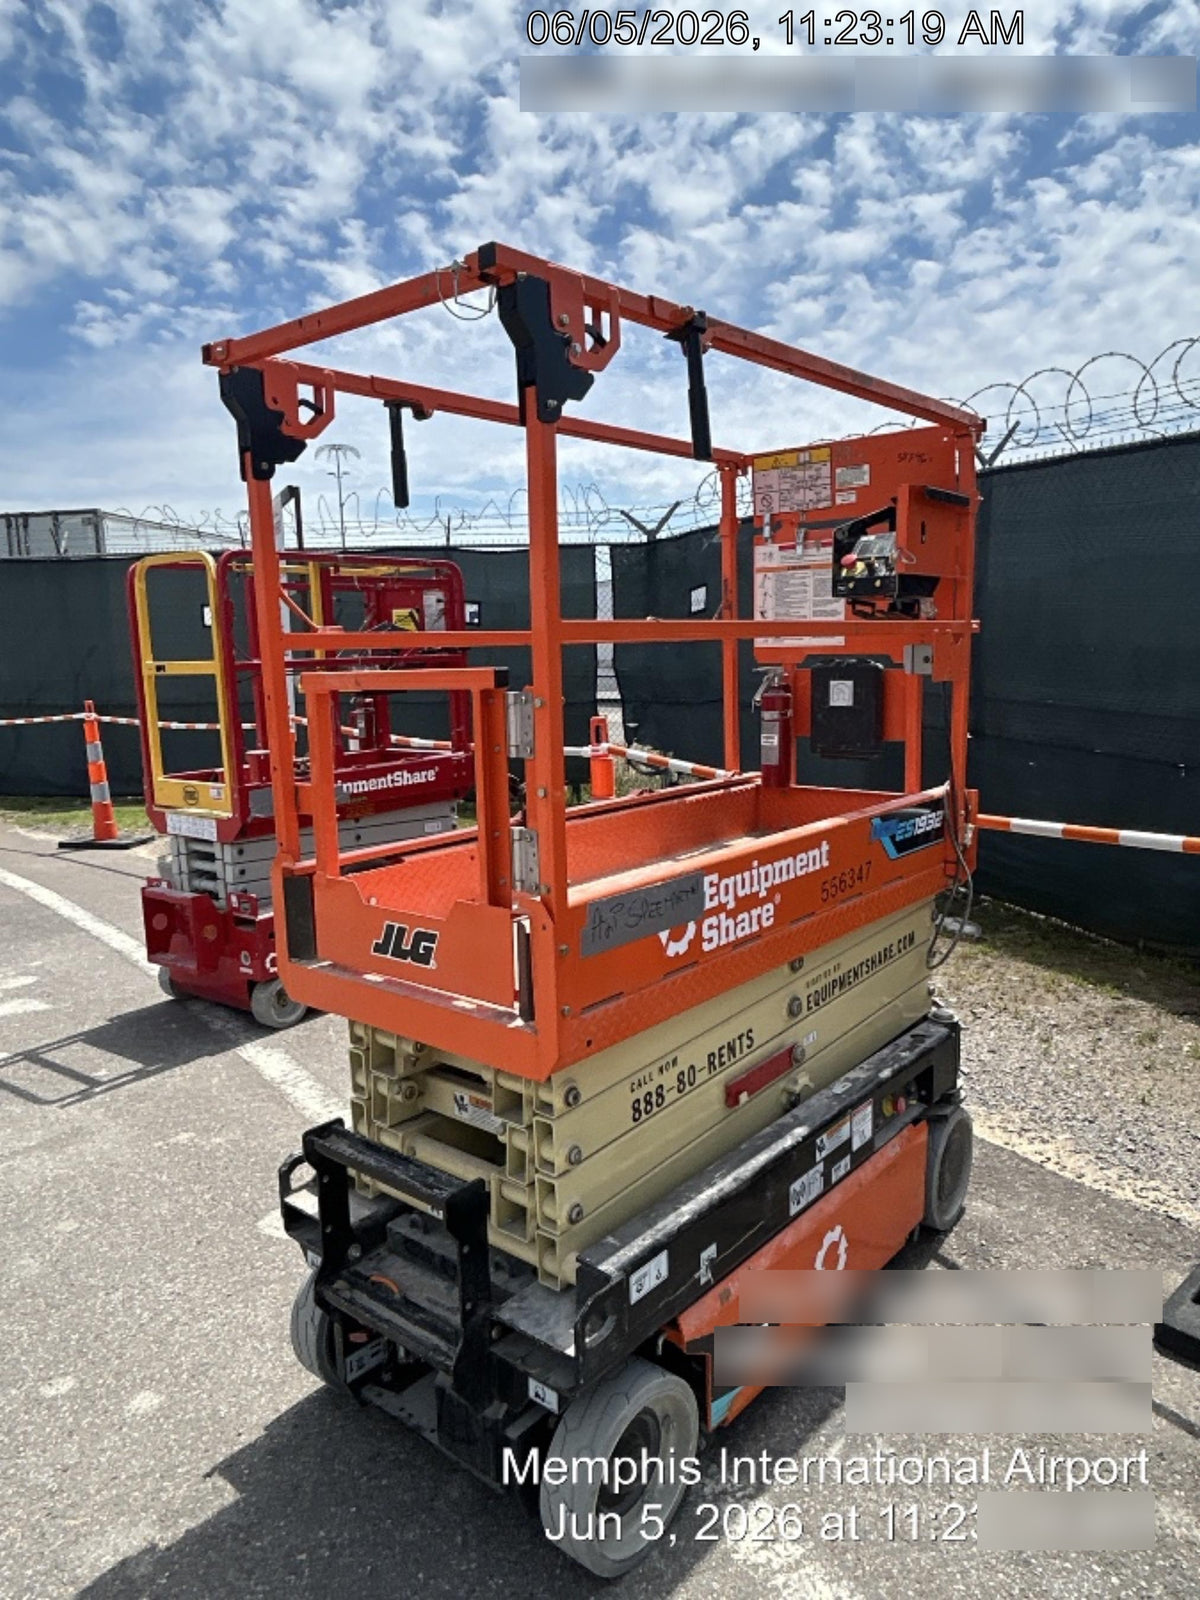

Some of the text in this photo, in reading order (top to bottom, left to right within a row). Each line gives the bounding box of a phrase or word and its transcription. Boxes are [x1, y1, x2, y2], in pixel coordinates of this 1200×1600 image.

[703, 840, 830, 912] Equipment
[820, 861, 872, 903] 556347
[371, 921, 440, 969] JLG
[701, 902, 775, 952] Share
[806, 930, 915, 1012] EQUIPMENTSHARE.COM
[630, 1055, 678, 1093] CALL NOW
[631, 1028, 755, 1122] 888-80-RENTS
